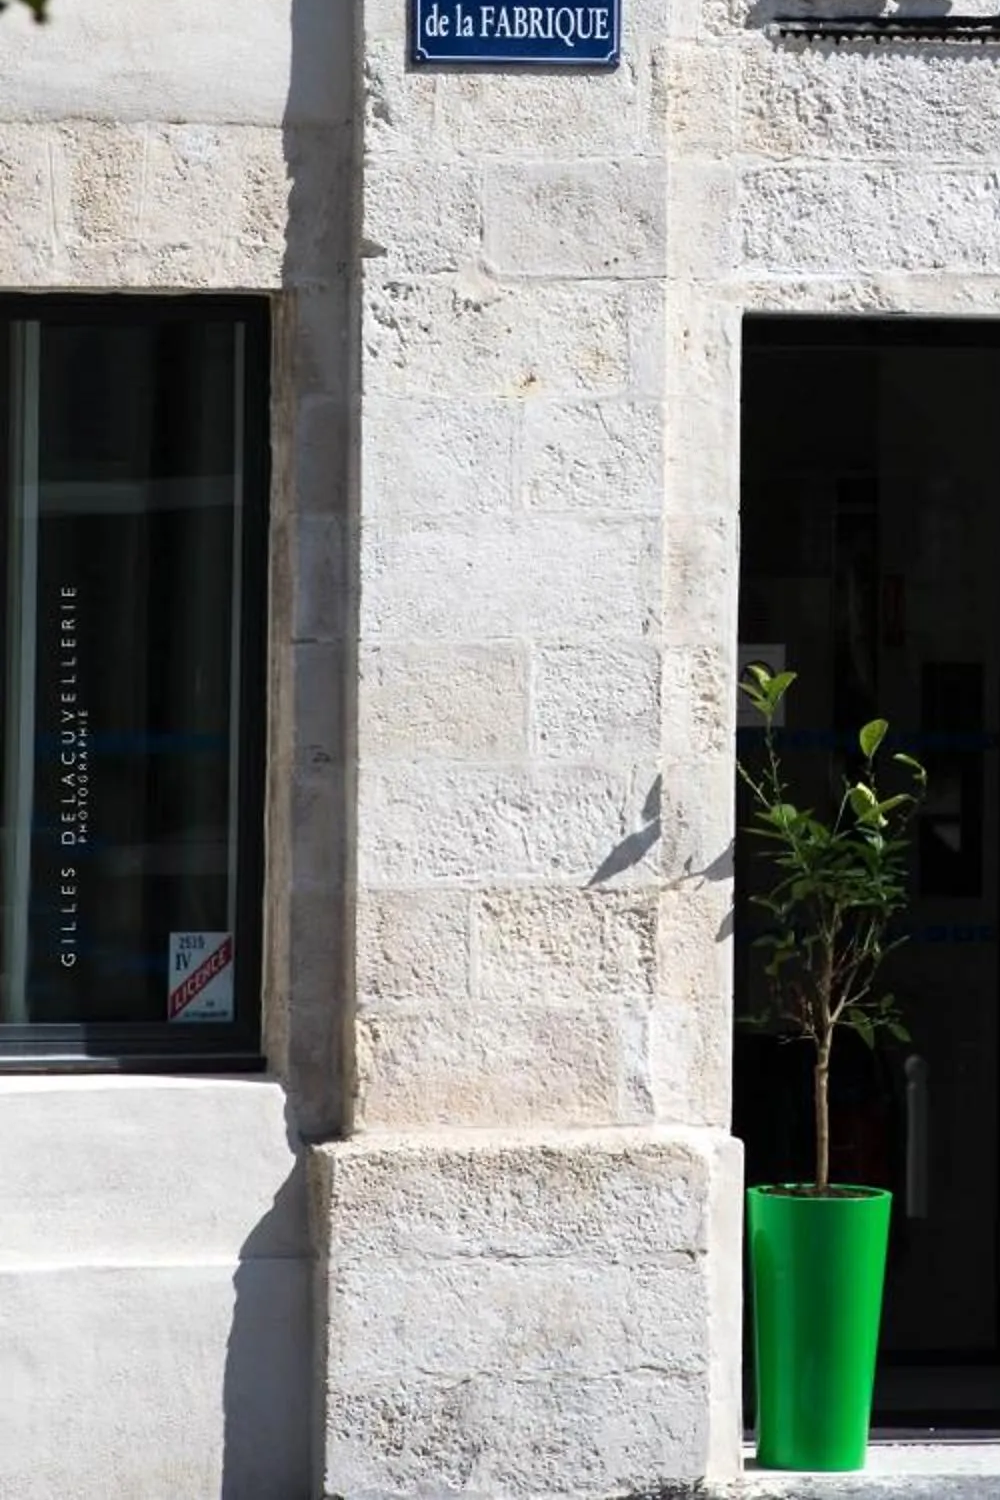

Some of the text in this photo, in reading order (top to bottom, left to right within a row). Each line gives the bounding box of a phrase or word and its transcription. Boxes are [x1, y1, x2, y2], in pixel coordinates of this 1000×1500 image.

[425, 3, 610, 48] de la FABRIQUE
[60, 586, 77, 968] GILLES DELACUVELLERIE
[77, 708, 89, 844] PHOTOGRAPHIE
[173, 945, 230, 1012] LICENCE
[175, 952, 192, 971] IV
